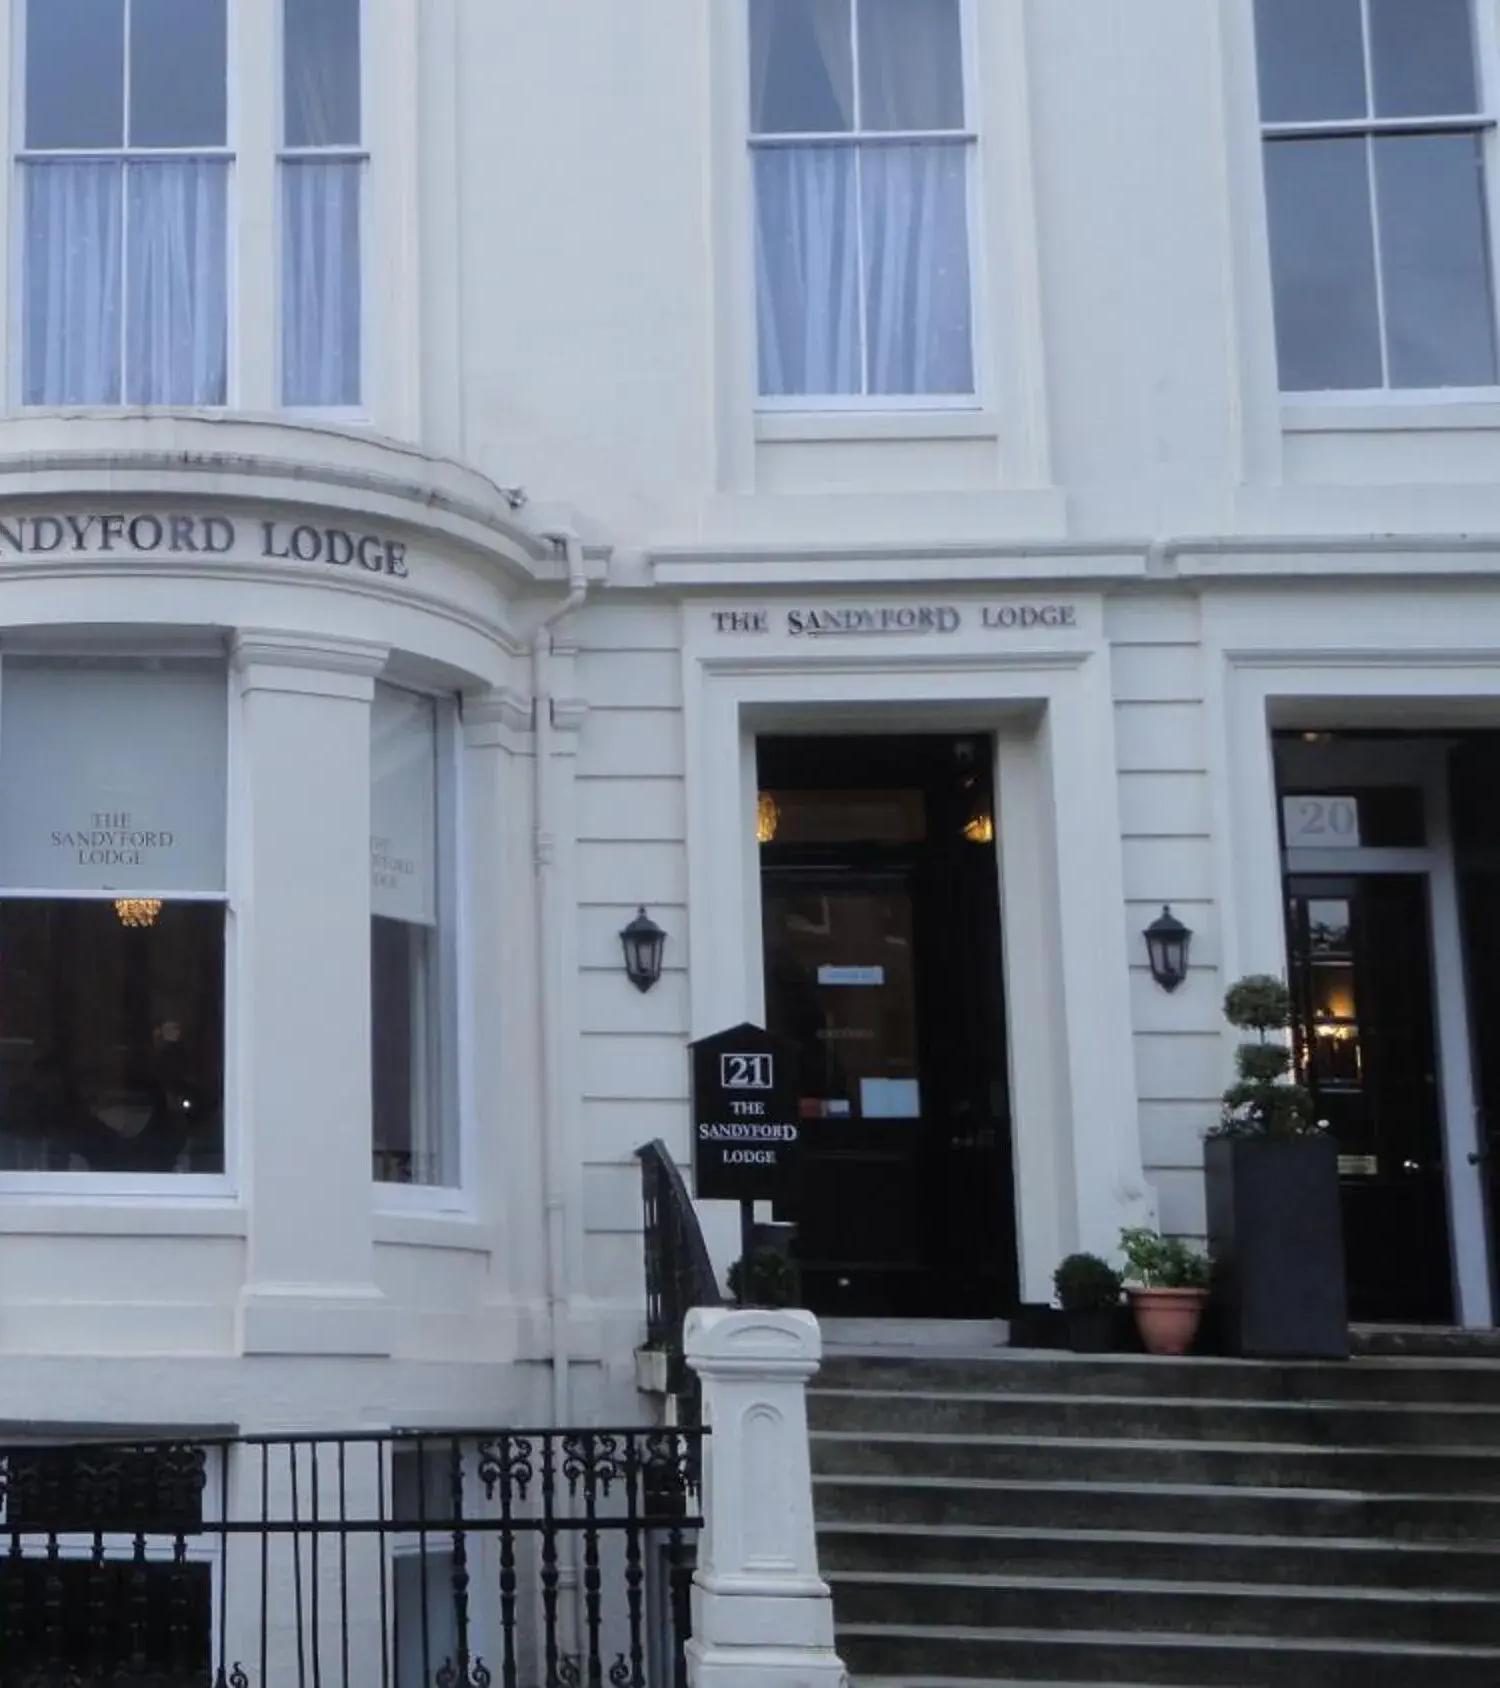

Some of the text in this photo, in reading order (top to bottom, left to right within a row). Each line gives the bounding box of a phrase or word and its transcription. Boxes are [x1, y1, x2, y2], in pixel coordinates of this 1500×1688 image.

[261, 521, 410, 579] LODGE
[711, 605, 1076, 637] THE SANDYFORD LODGE
[91, 811, 133, 828] THE
[1299, 802, 1355, 835] 20
[50, 830, 174, 848] SANDYFORD
[78, 849, 143, 865] LODGE
[729, 1057, 763, 1085] 21
[730, 1101, 765, 1115] THE
[699, 1124, 798, 1141] SANDYFORD
[722, 1150, 776, 1163] LODGE
